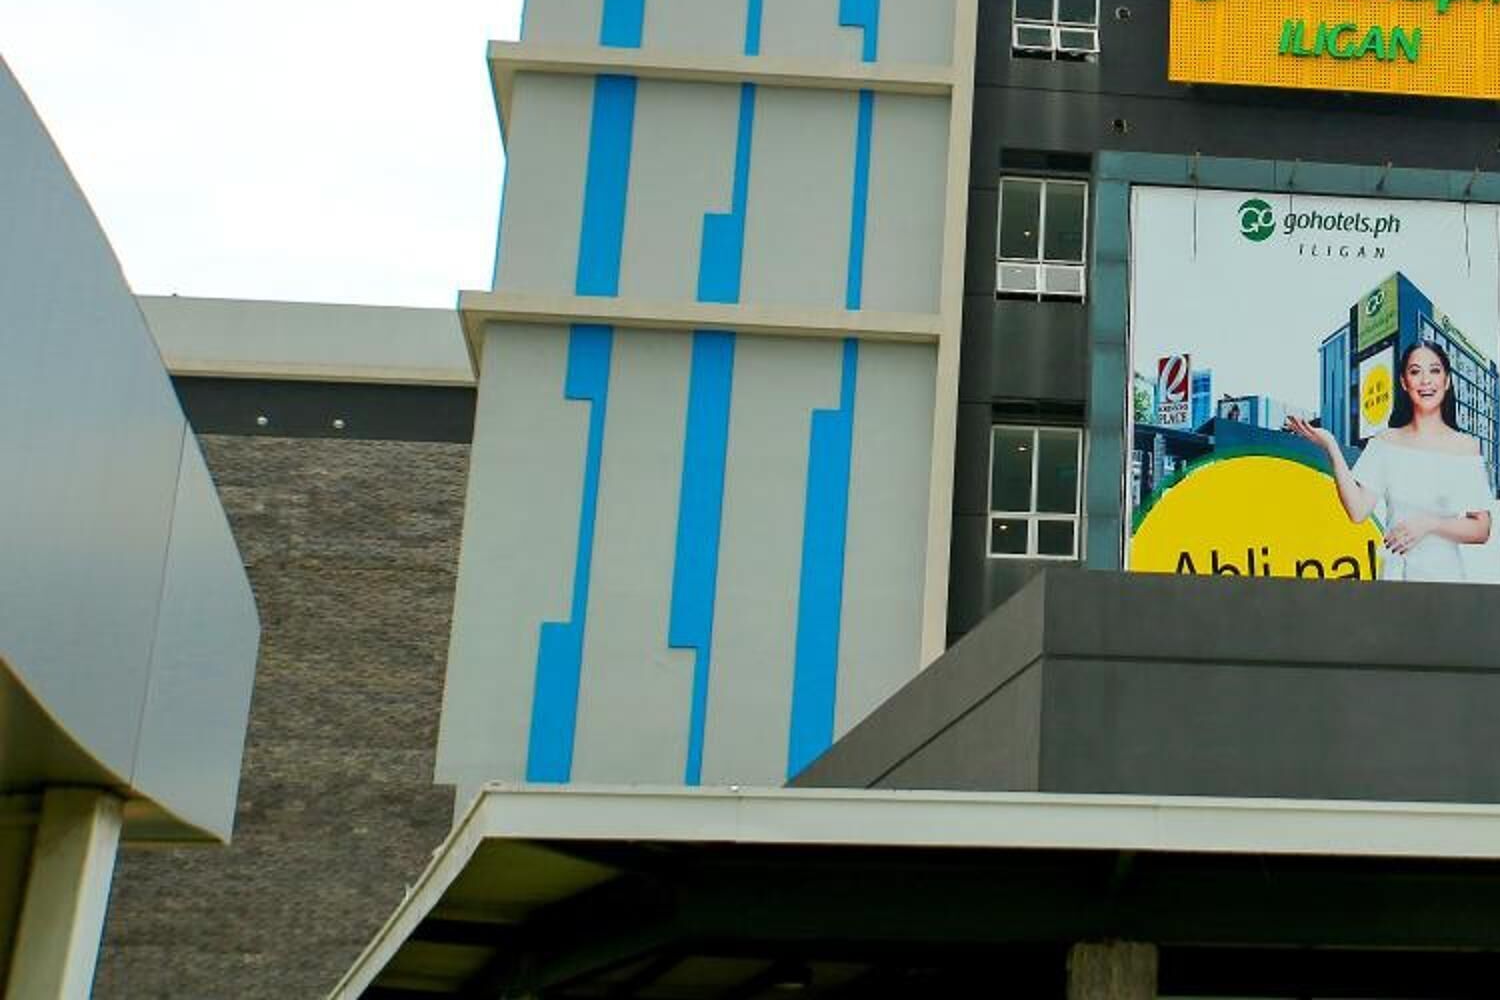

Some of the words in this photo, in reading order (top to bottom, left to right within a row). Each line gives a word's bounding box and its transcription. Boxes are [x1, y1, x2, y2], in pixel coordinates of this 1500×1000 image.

[1277, 18, 1423, 62] ILIGAN
[1283, 211, 1401, 239] gohotels.ph
[1299, 243, 1386, 259] ILIGAN
